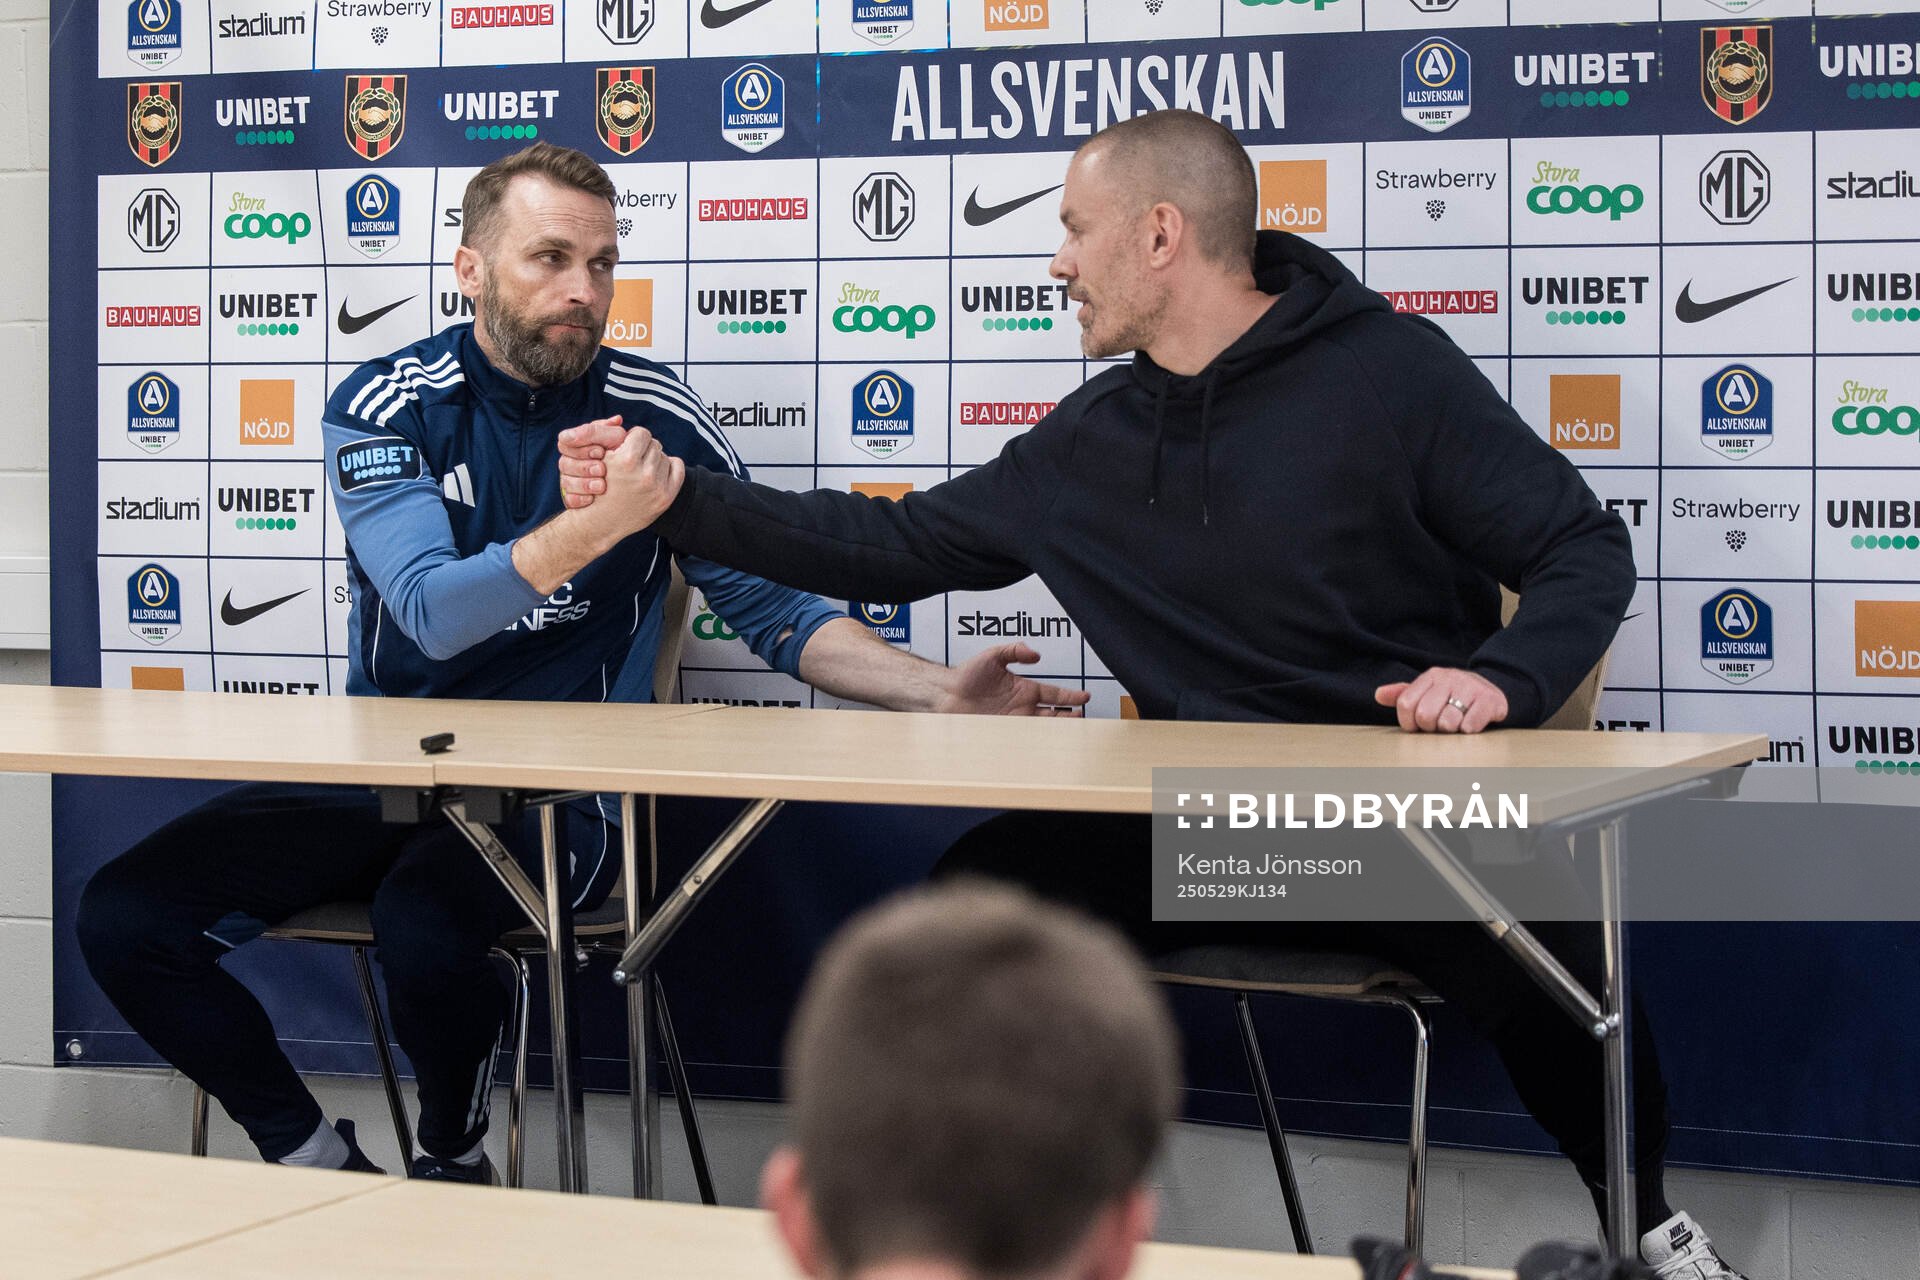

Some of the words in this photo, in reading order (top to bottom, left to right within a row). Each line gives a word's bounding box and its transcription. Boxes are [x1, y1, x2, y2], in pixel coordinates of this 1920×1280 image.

[327, 0, 432, 18] Strawberry
[452, 6, 553, 27] BAUHAUS
[857, 5, 908, 18] ALLSVENSKAN
[989, 1, 1044, 24] NÖJD
[218, 13, 305, 38] stadium
[867, 25, 898, 34] UNIBET
[132, 34, 177, 46] ALLSVENSKAN
[140, 52, 168, 60] UNIBET
[1820, 43, 1920, 77] UNIB
[1514, 52, 1655, 86] UNIBET
[444, 90, 560, 121] UNIBET
[891, 50, 1285, 142] ALLSVENSKAN
[1407, 89, 1464, 103] ALLSVENSKAN
[216, 96, 311, 127] UNIBET
[728, 112, 779, 125] ALLSVENSKAN
[1418, 110, 1453, 120] UNIBET
[737, 132, 769, 141] UNIBET
[1376, 168, 1497, 191] Strawberry
[1532, 160, 1580, 184] Stora
[1706, 157, 1765, 219] MG
[1827, 170, 1920, 199] stadiu
[229, 192, 266, 211] Stora
[615, 189, 678, 210] wberry
[700, 198, 808, 219] BAUHAUS
[859, 179, 909, 235] MG
[1526, 183, 1645, 221] coop
[132, 194, 176, 242] MG
[1266, 203, 1322, 226] NÖJD
[224, 212, 312, 244] coop
[351, 221, 395, 233] ALLSVENSKAN
[360, 240, 386, 248] UNIBET
[838, 282, 880, 304] Stora
[961, 285, 1069, 312] UNIBET
[1522, 276, 1650, 305] UNIBET
[1828, 272, 1920, 302] UNIB
[219, 293, 317, 319] UNIBET
[697, 288, 808, 315] UNIBET
[106, 306, 201, 326] BAUHAUS
[832, 305, 936, 339] coop
[1838, 380, 1889, 404] Stora
[132, 417, 176, 429] ALLSVENSKAN
[706, 402, 806, 427] tadium
[962, 404, 1054, 422] BAUHA
[1707, 417, 1767, 430] ALLSVENSKAN
[1832, 405, 1920, 442] coo
[244, 420, 290, 439] NÖJD
[856, 419, 909, 431] ALLSVENSKAN
[1555, 420, 1615, 442] NÖJD
[141, 435, 167, 443] UNIBET
[867, 439, 898, 448] UNIBET
[1718, 439, 1755, 448] UNIBET
[341, 446, 414, 472] UNIBET
[106, 496, 200, 521] stadium
[218, 487, 315, 513] UNIBET
[1672, 497, 1801, 522] Strawberry
[1827, 500, 1920, 529] UNIB
[132, 608, 177, 620] ALLSVENSKAN
[957, 609, 1072, 638] stadium
[142, 627, 169, 635] UNIBET
[1706, 641, 1767, 655] ALLSVENSKAN
[1861, 645, 1920, 670] NÖJD
[1719, 663, 1756, 672] UNIBET
[1828, 725, 1920, 755] UNIB
[1669, 1221, 1687, 1240] NIKE
